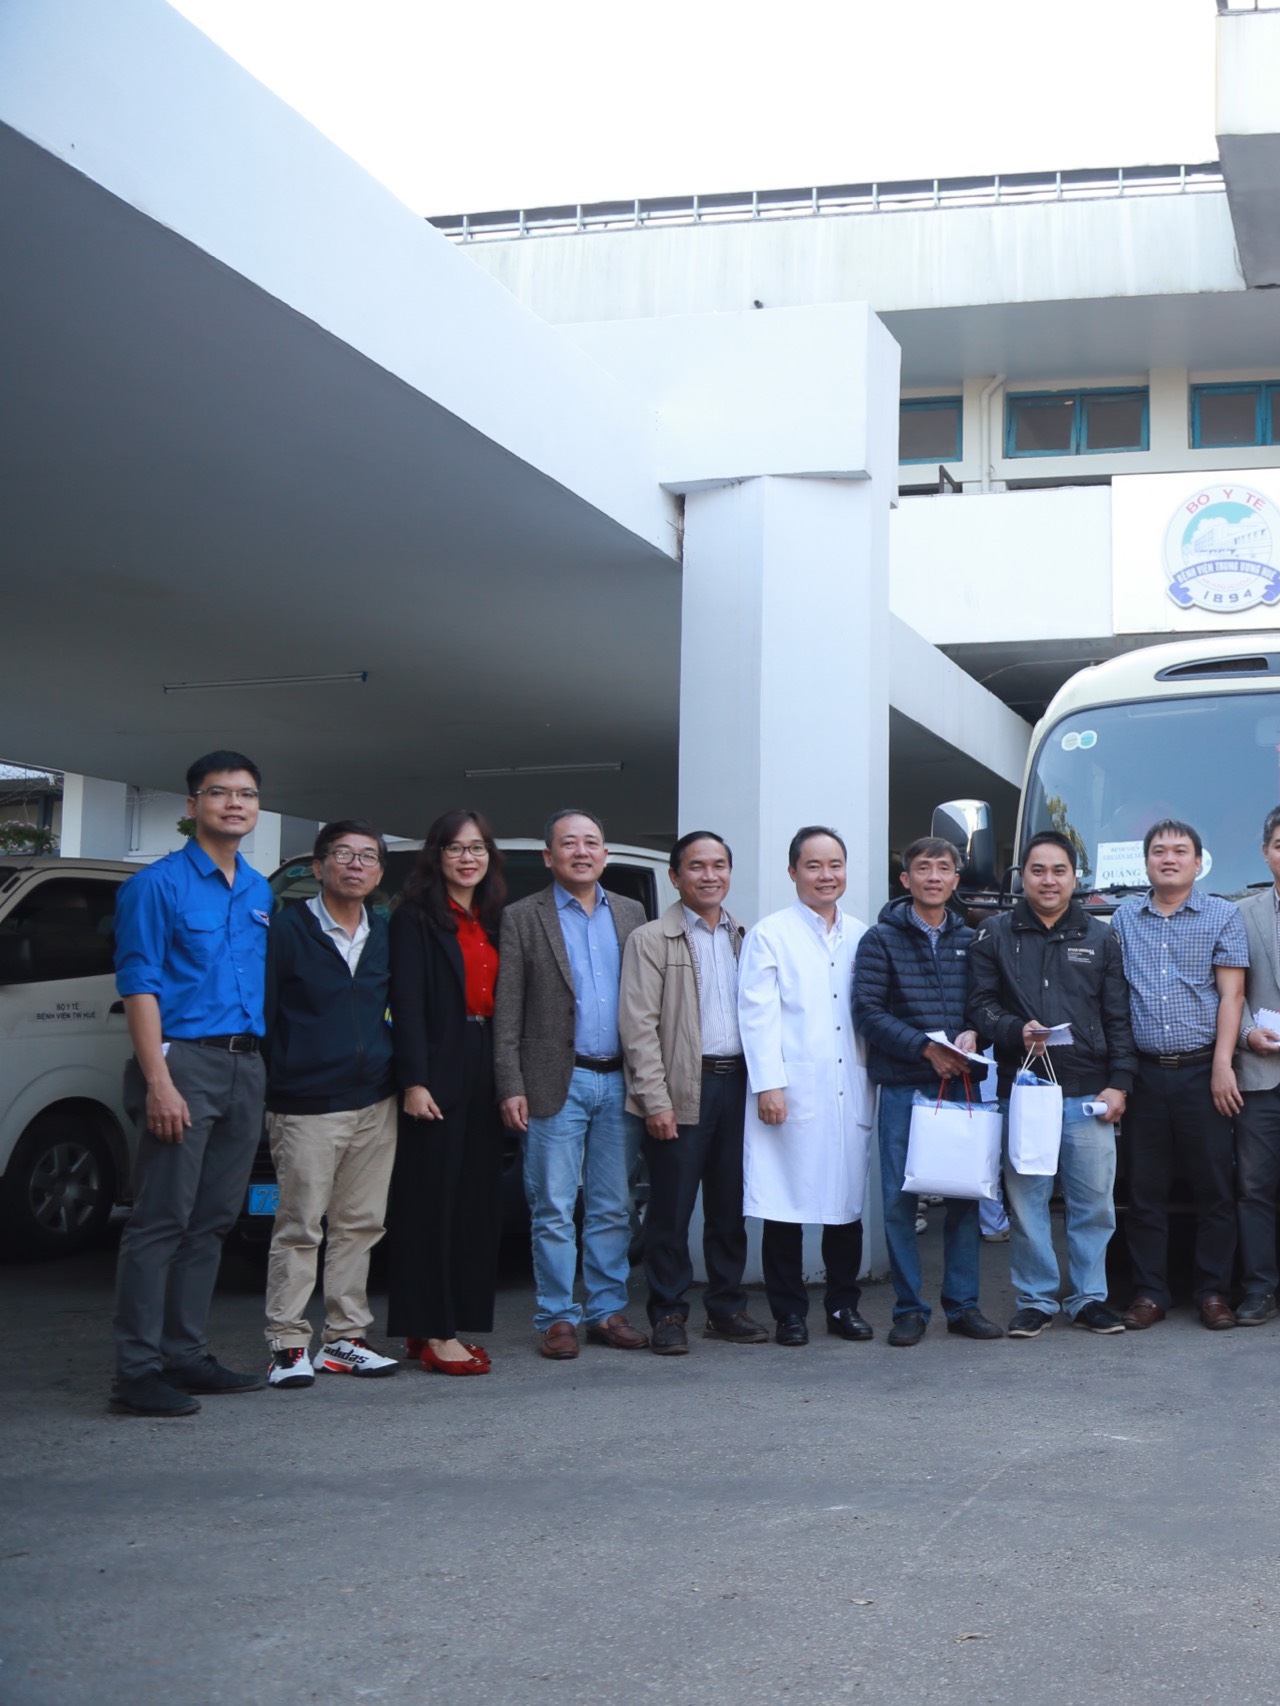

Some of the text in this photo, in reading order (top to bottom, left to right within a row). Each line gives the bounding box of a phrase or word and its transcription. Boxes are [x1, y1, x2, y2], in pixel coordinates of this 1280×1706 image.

[1222, 488, 1234, 500] Y
[1203, 588, 1253, 603] 1894
[322, 1345, 370, 1364] adidas
